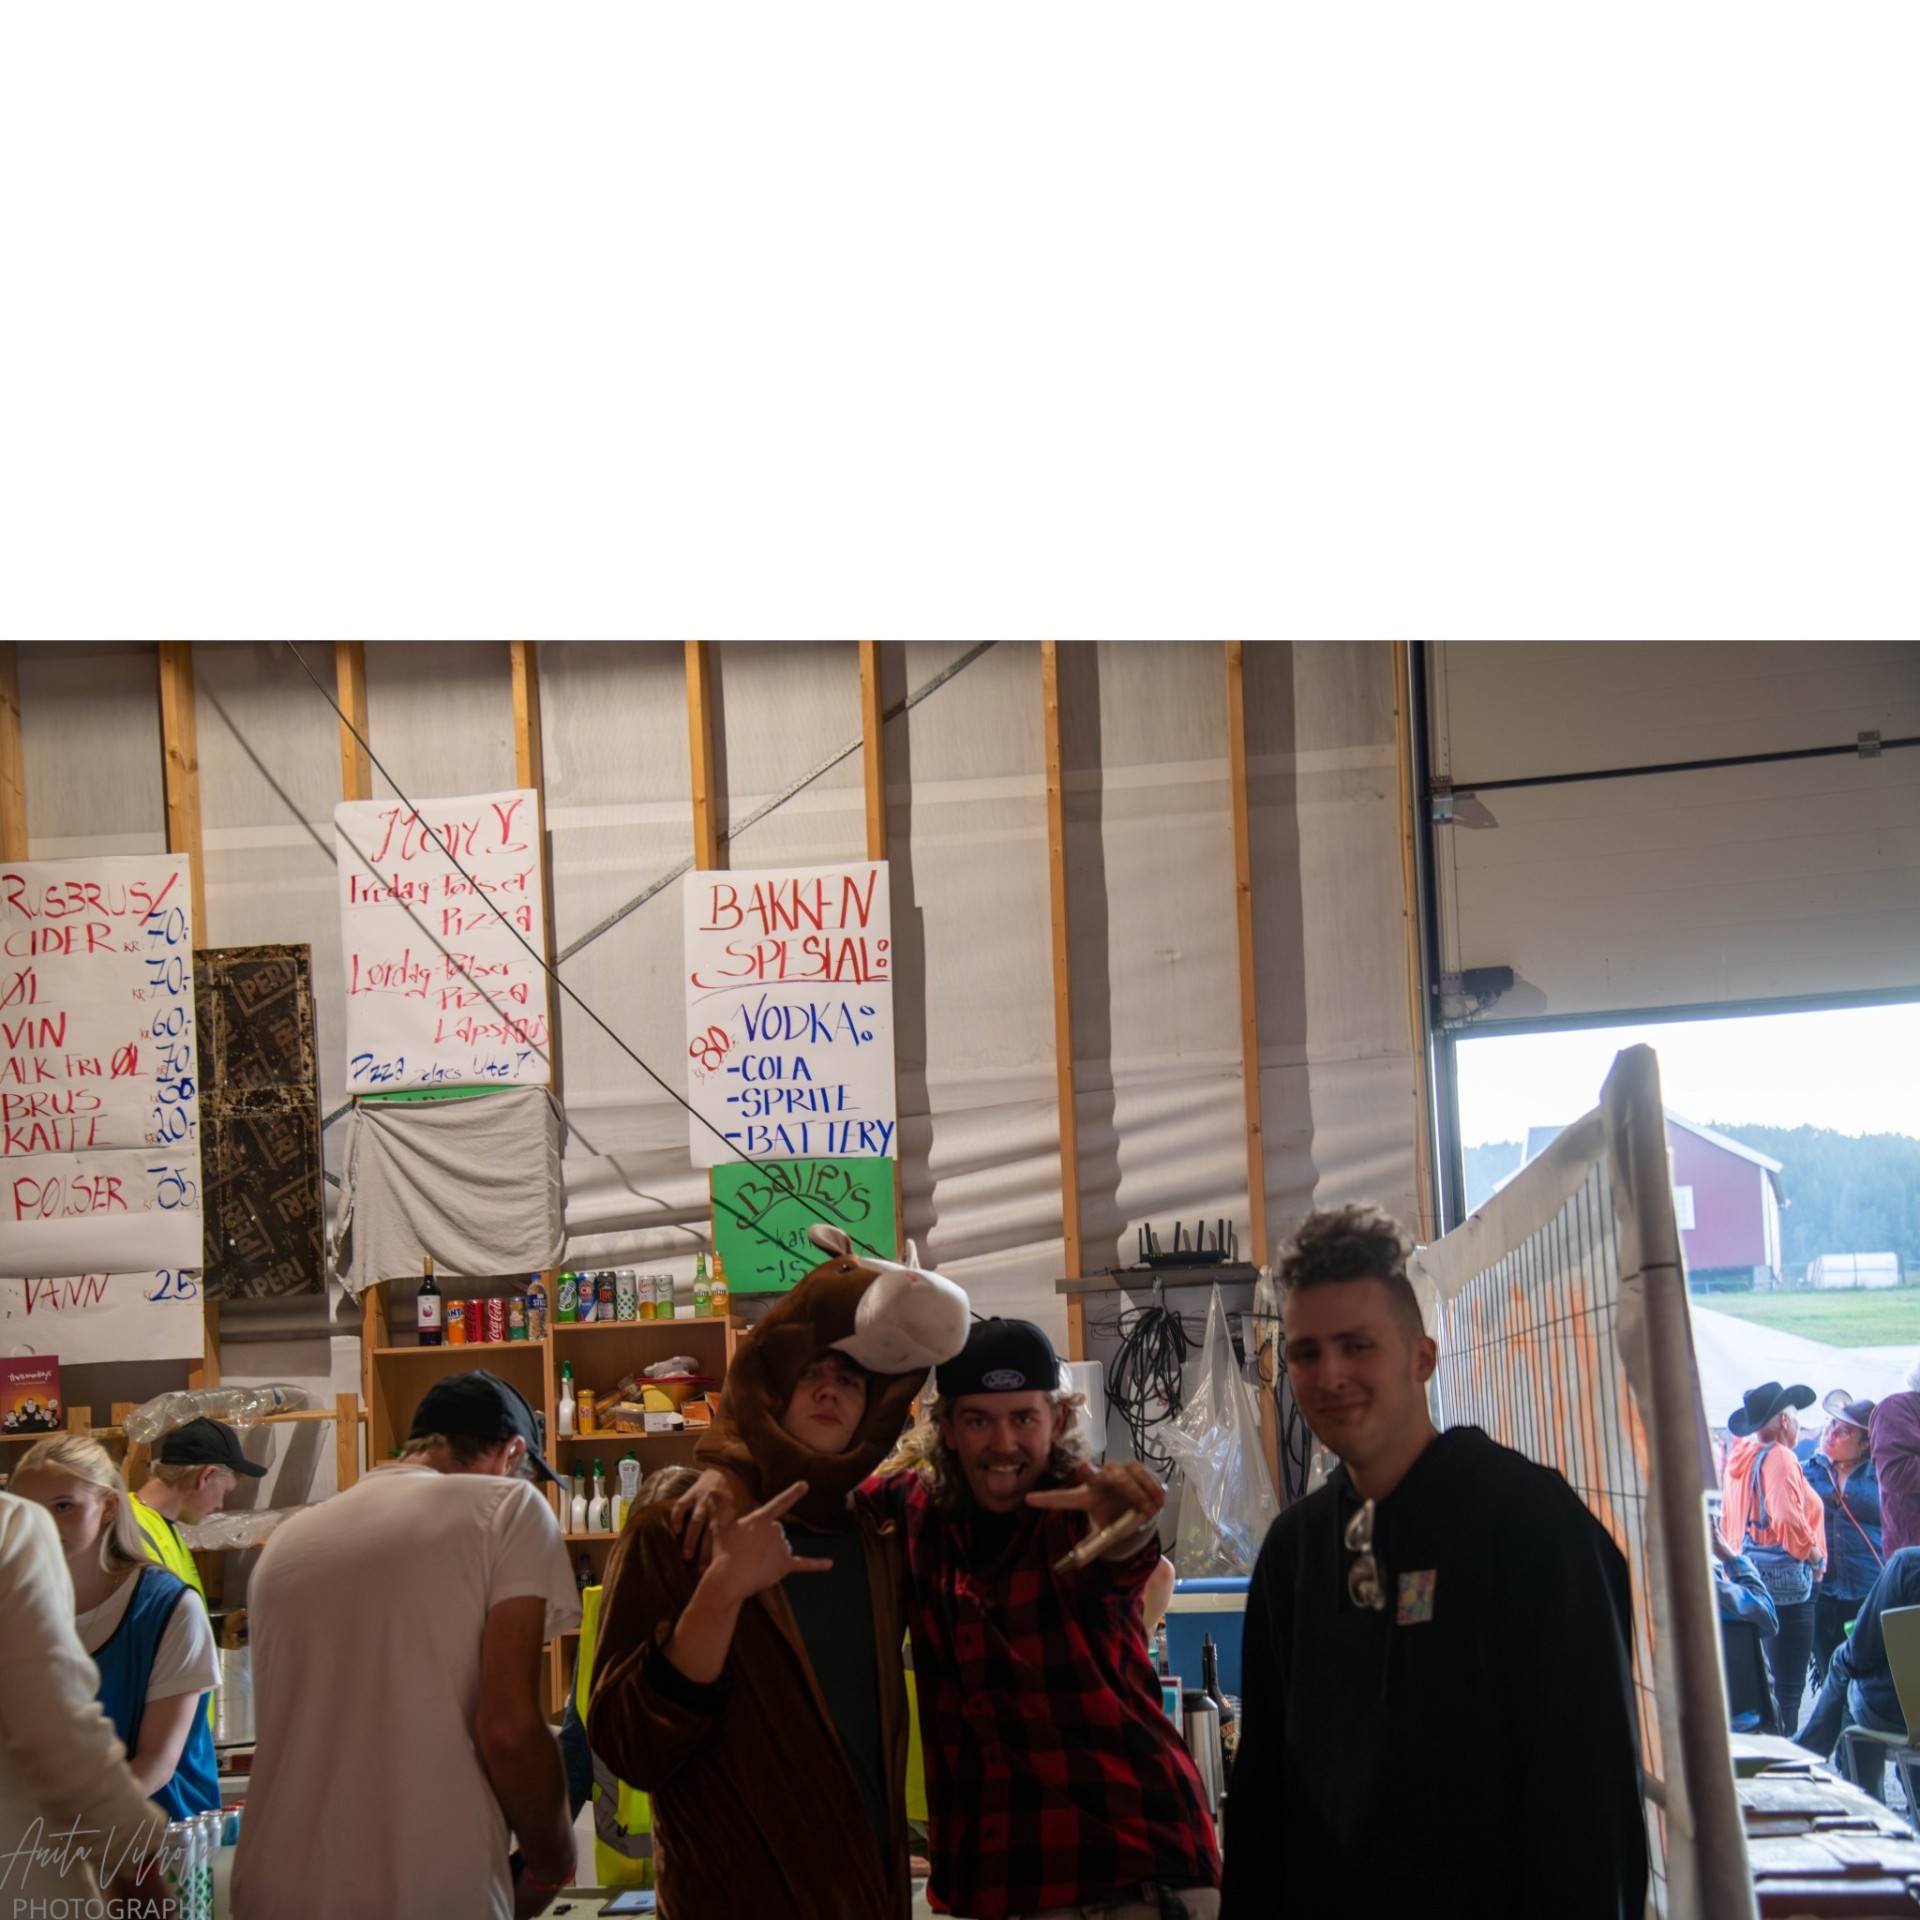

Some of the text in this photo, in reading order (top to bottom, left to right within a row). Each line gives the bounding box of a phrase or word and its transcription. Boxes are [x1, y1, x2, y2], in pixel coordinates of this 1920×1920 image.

[440, 904, 531, 936] Pizza
[700, 870, 877, 935] BAKKEN
[4, 922, 117, 957] CIDER
[240, 958, 293, 1004] PERI
[716, 936, 889, 985] SPESIAL:
[0, 965, 52, 1008] ØL
[433, 982, 529, 1010] Pizza
[2, 1011, 66, 1049] VIN
[731, 993, 876, 1046] VODKA:
[110, 1043, 148, 1080] ØL
[2, 1089, 101, 1122] BRUS
[4, 1114, 112, 1154] KAFFE
[13, 1175, 128, 1220] PØLSER
[24, 1273, 110, 1314] VANN
[252, 1256, 306, 1298] PERI
